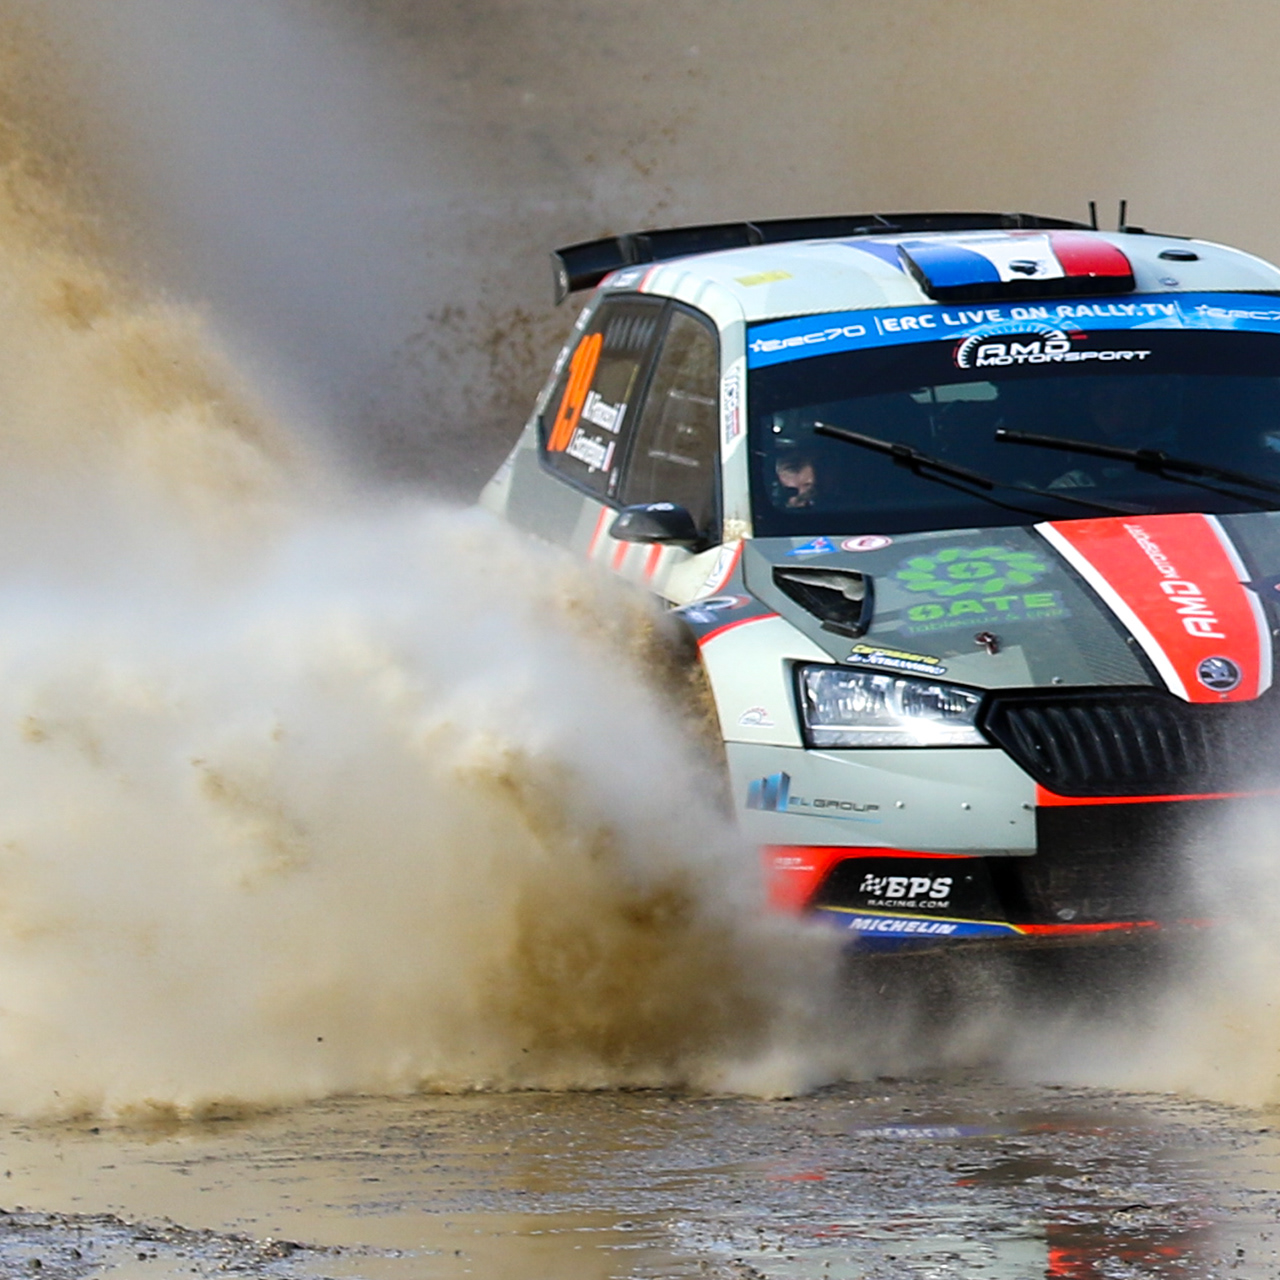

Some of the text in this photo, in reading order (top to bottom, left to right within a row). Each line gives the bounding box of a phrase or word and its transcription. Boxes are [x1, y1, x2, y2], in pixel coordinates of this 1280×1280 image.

[883, 303, 1174, 332] ERC LIVE ON RALLY.TV
[976, 350, 1152, 367] MOTORSPORT
[977, 340, 1071, 359] AMD
[1123, 523, 1226, 639] AMD MOTORSPORT
[813, 799, 880, 812] GROUP
[867, 899, 950, 909] RACING.COM
[848, 917, 958, 935] MICHELIN
